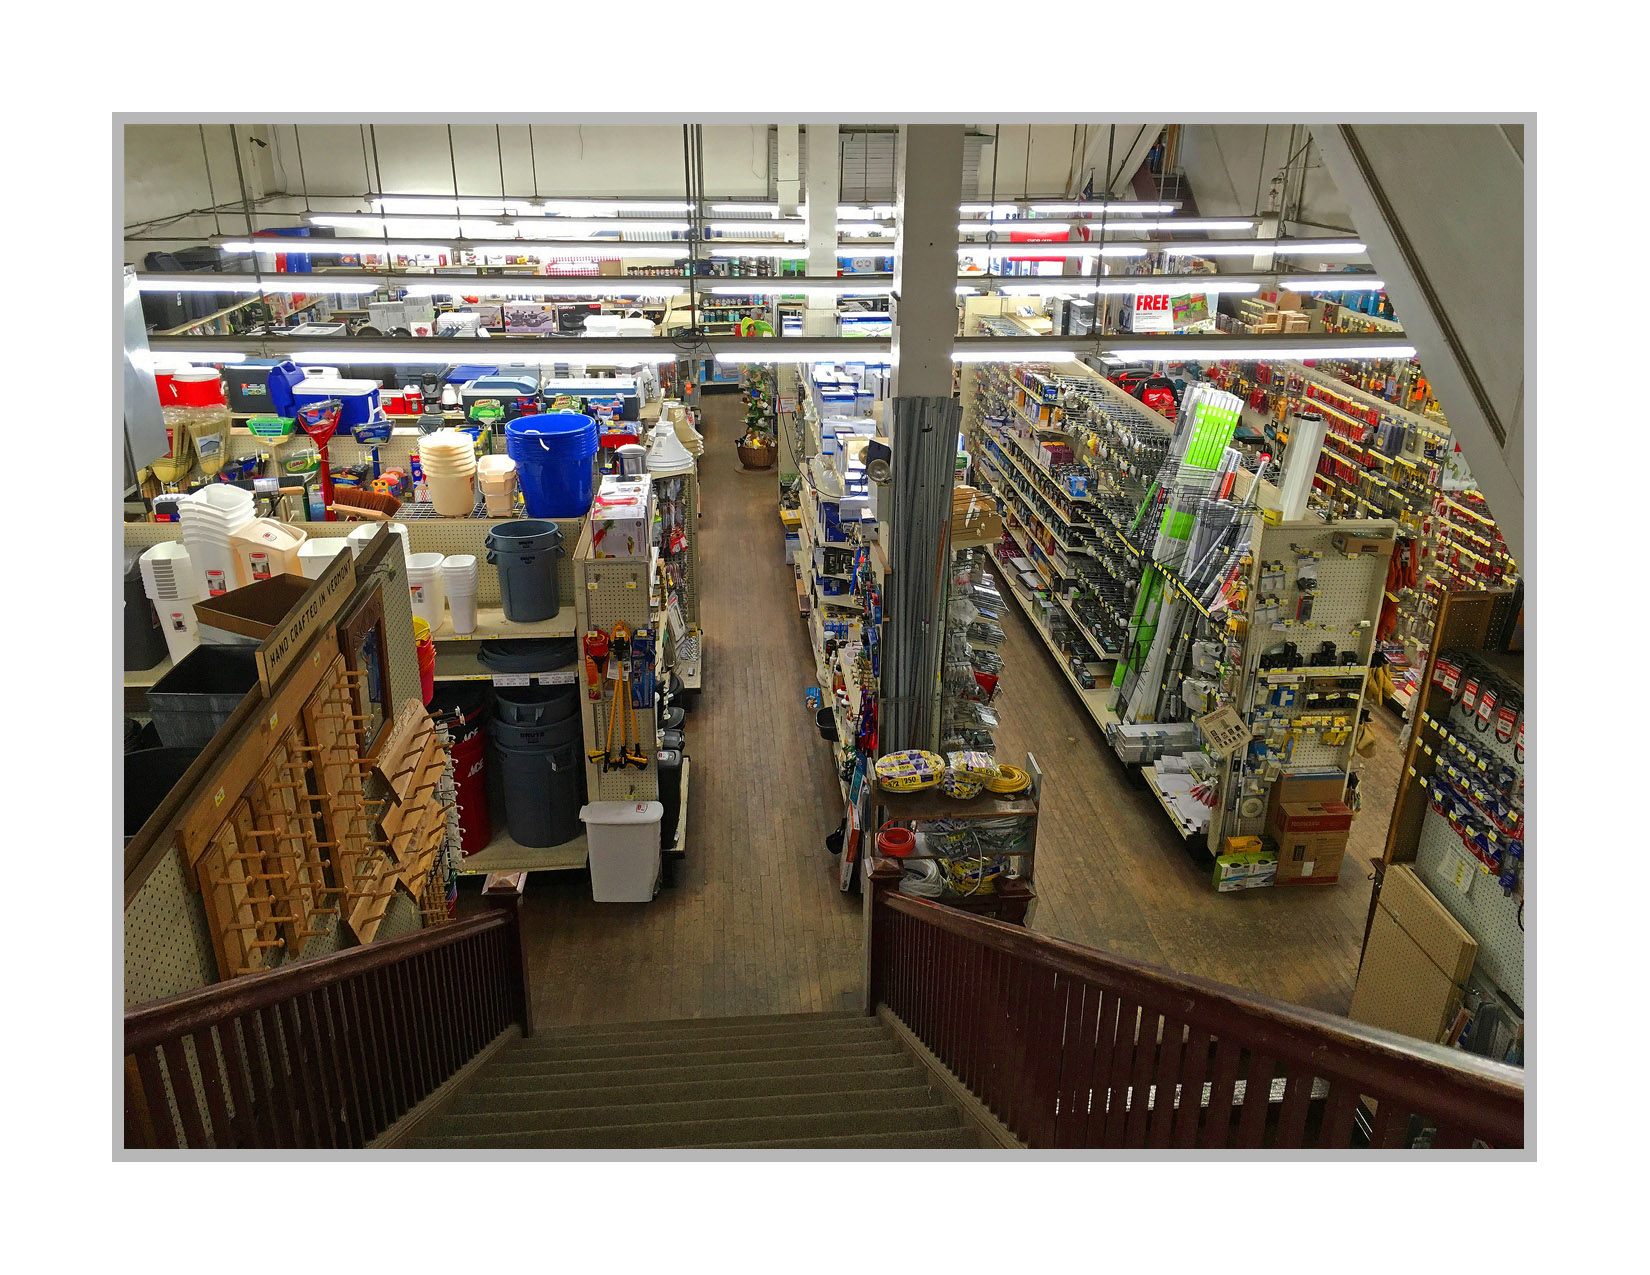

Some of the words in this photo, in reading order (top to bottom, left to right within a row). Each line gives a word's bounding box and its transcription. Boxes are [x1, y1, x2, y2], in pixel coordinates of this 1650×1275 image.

[1136, 294, 1170, 311] FREE
[269, 636, 289, 668] HAND
[290, 601, 318, 642] CRAFTED
[318, 592, 326, 608] IN
[326, 557, 351, 595] VERMONT
[467, 758, 484, 778] ACE
[903, 776, 917, 785] 250
